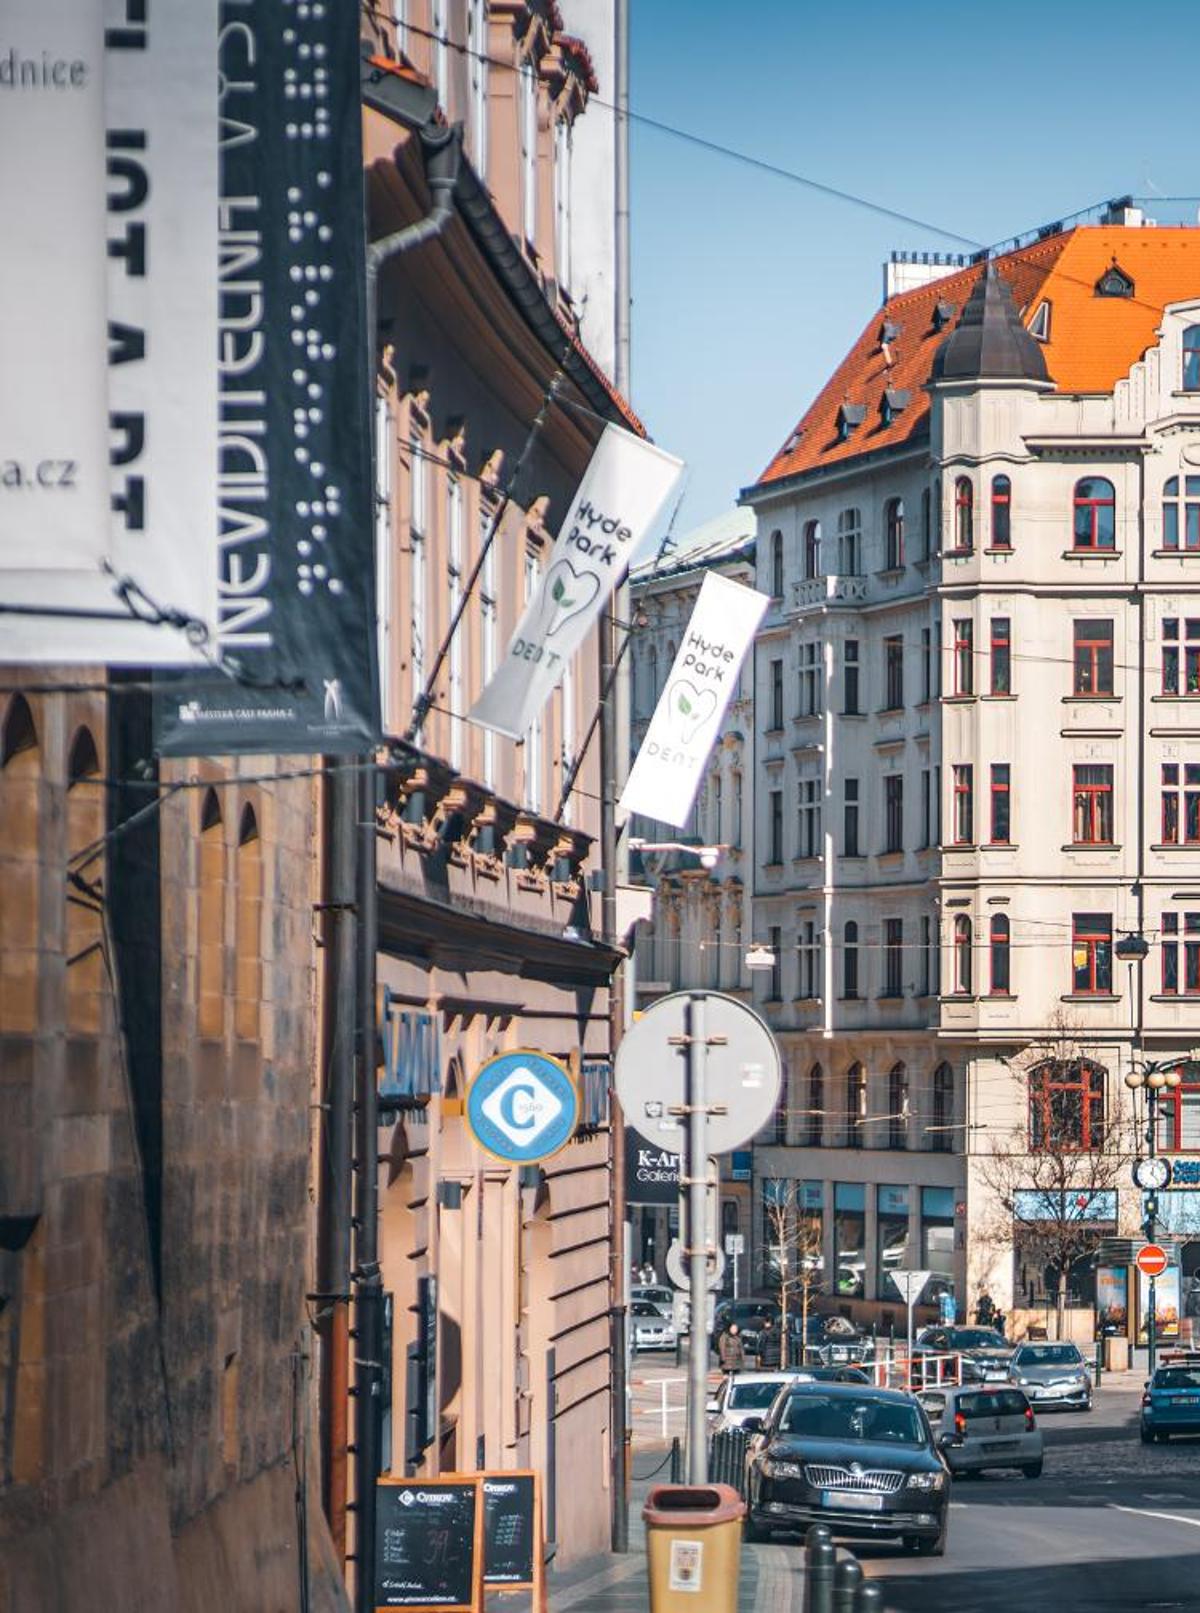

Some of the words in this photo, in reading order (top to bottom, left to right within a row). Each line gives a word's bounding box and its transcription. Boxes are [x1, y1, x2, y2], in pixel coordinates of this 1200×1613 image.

[575, 498, 632, 542] Hyde
[688, 630, 734, 663] Hyde
[500, 1084, 535, 1129] C
